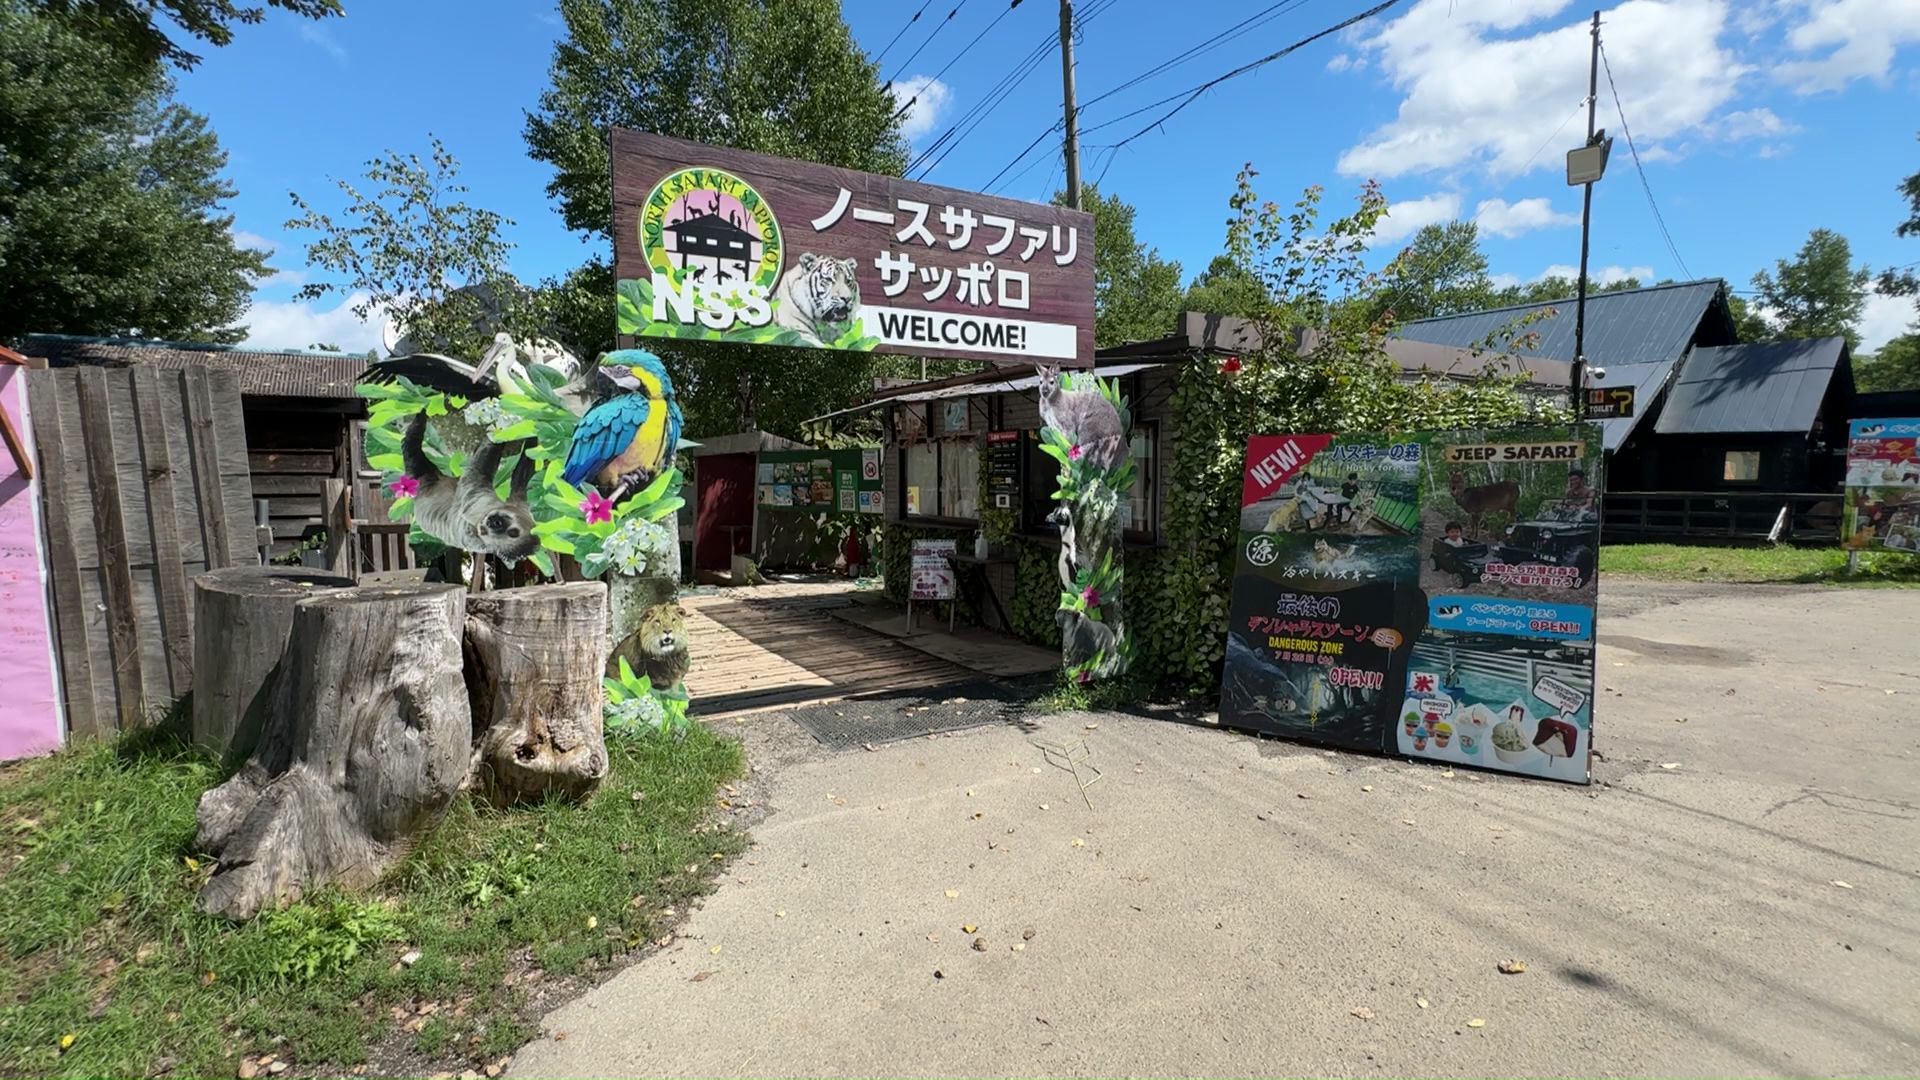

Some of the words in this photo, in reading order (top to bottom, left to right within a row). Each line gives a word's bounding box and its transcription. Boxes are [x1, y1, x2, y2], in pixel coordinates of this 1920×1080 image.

[644, 189, 675, 249] NORTH
[739, 189, 779, 264] SAPPORO
[810, 187, 1078, 267] ノースサファリ
[651, 271, 772, 330] NSS
[874, 250, 1030, 310] サッポロ
[878, 312, 1026, 349] WELCOME!
[1250, 439, 1306, 489] NEW!
[1332, 443, 1421, 461] ハスキーの森
[1451, 446, 1497, 461] JEEP
[1503, 445, 1578, 460] SAFARI
[1268, 636, 1319, 653] DANGEROUS
[1320, 641, 1344, 655] ZONE
[1329, 667, 1384, 691] OPEN!!
